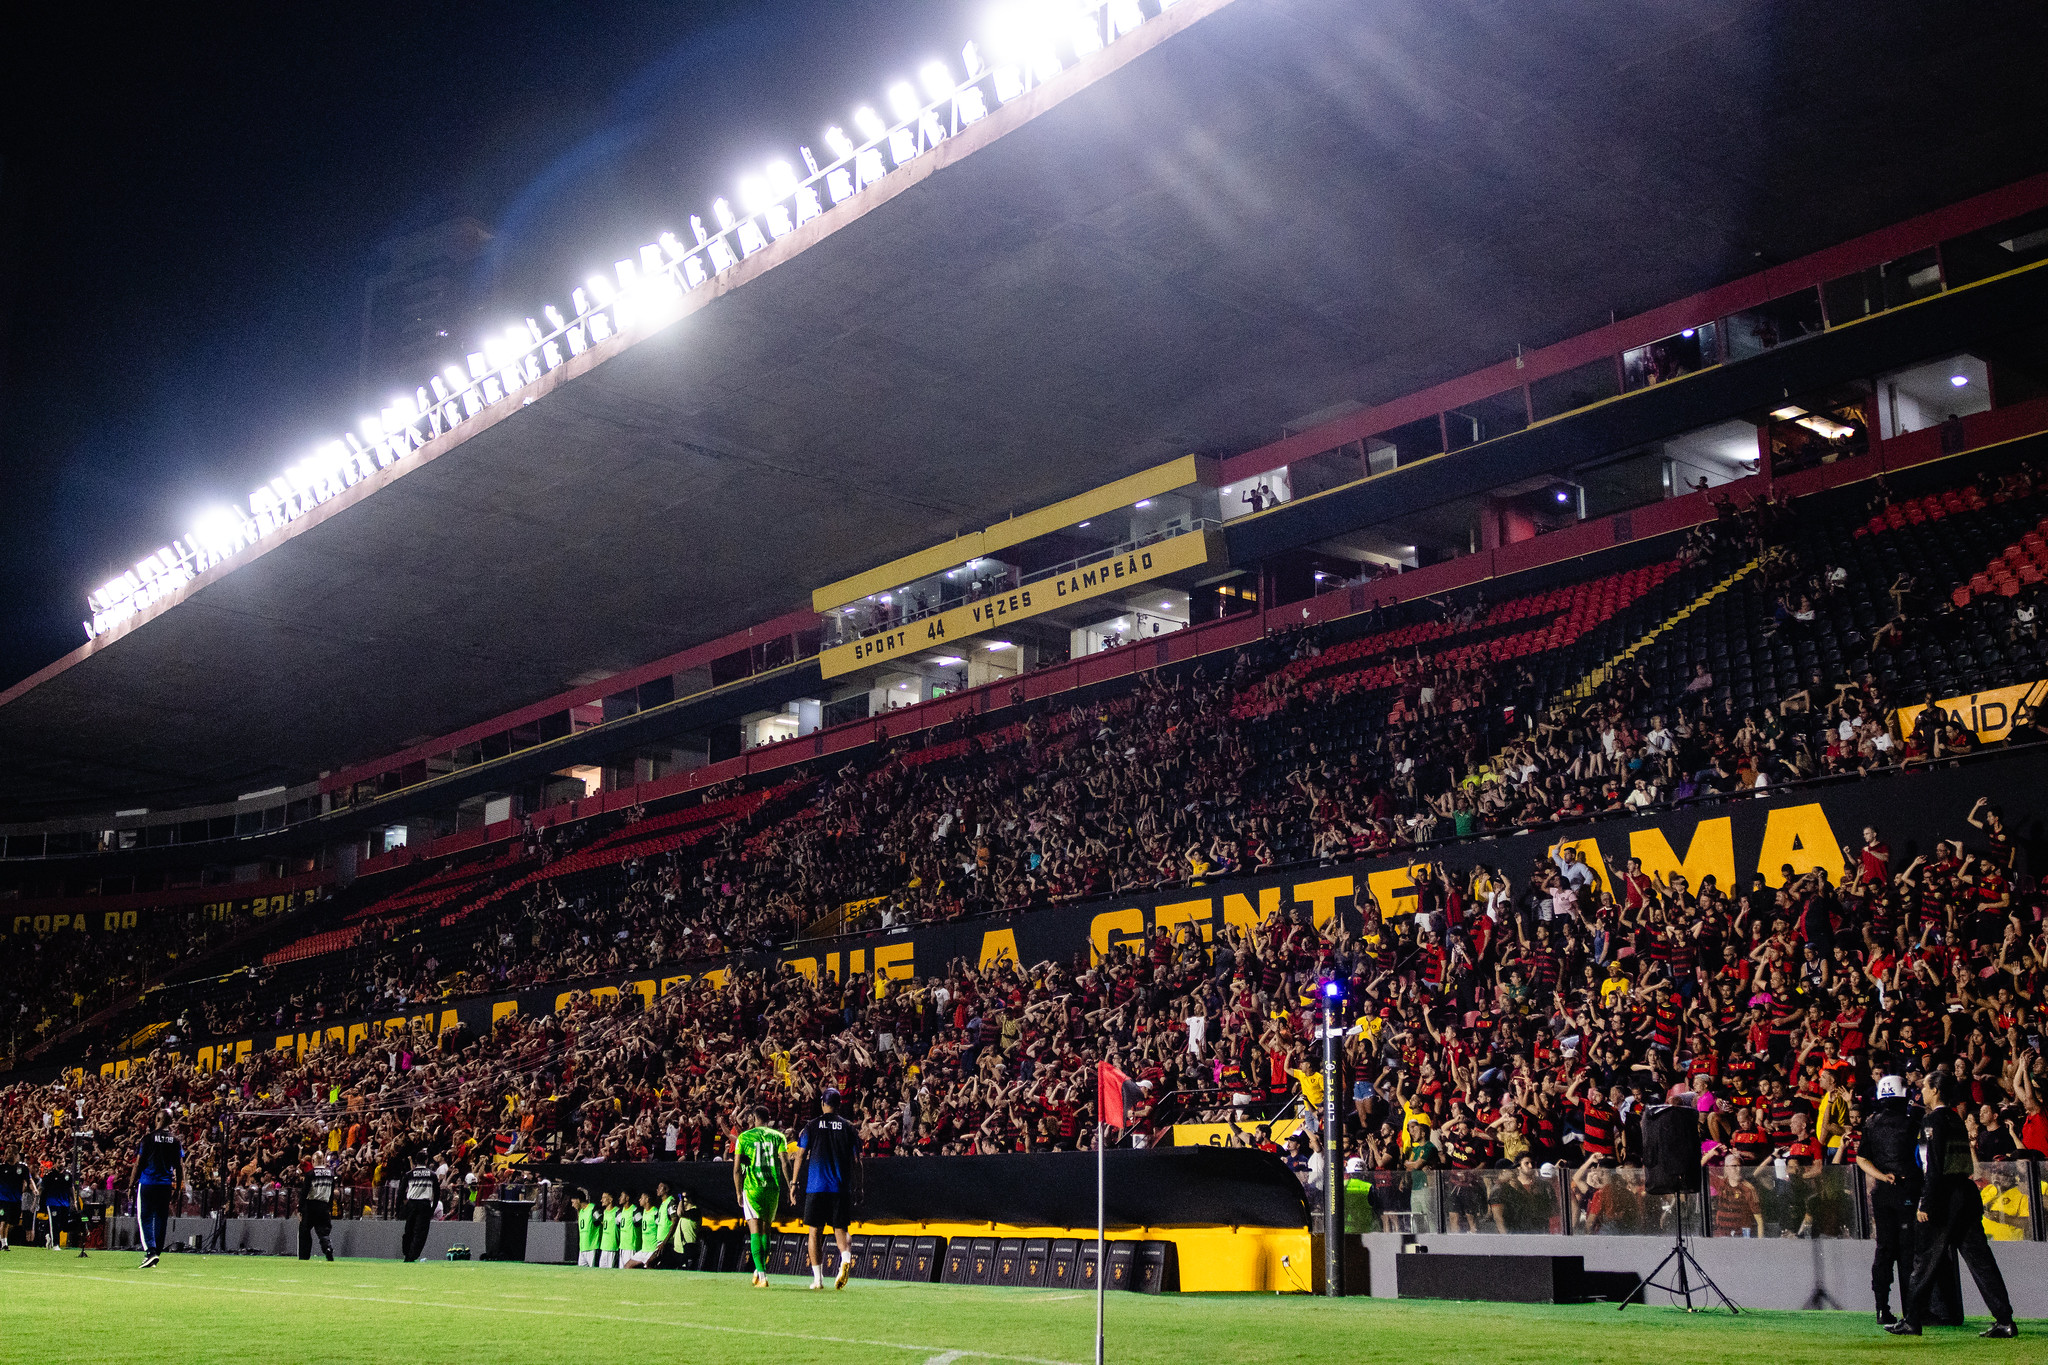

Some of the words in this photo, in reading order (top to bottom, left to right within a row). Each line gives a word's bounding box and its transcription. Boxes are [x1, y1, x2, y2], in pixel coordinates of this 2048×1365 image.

[855, 632, 905, 659] SPORT
[928, 619, 945, 640] 44
[973, 591, 1031, 622] VEZES
[1057, 553, 1152, 597] CAMPEÃO
[1948, 694, 2034, 734] AÍDA
[978, 928, 1019, 972] A
[1090, 863, 1432, 968] GENTE
[1547, 802, 1846, 905] AMA
[13, 914, 86, 934] COPA
[1327, 1076, 1335, 1122] LIDEYE
[818, 1120, 842, 1130] ALOS
